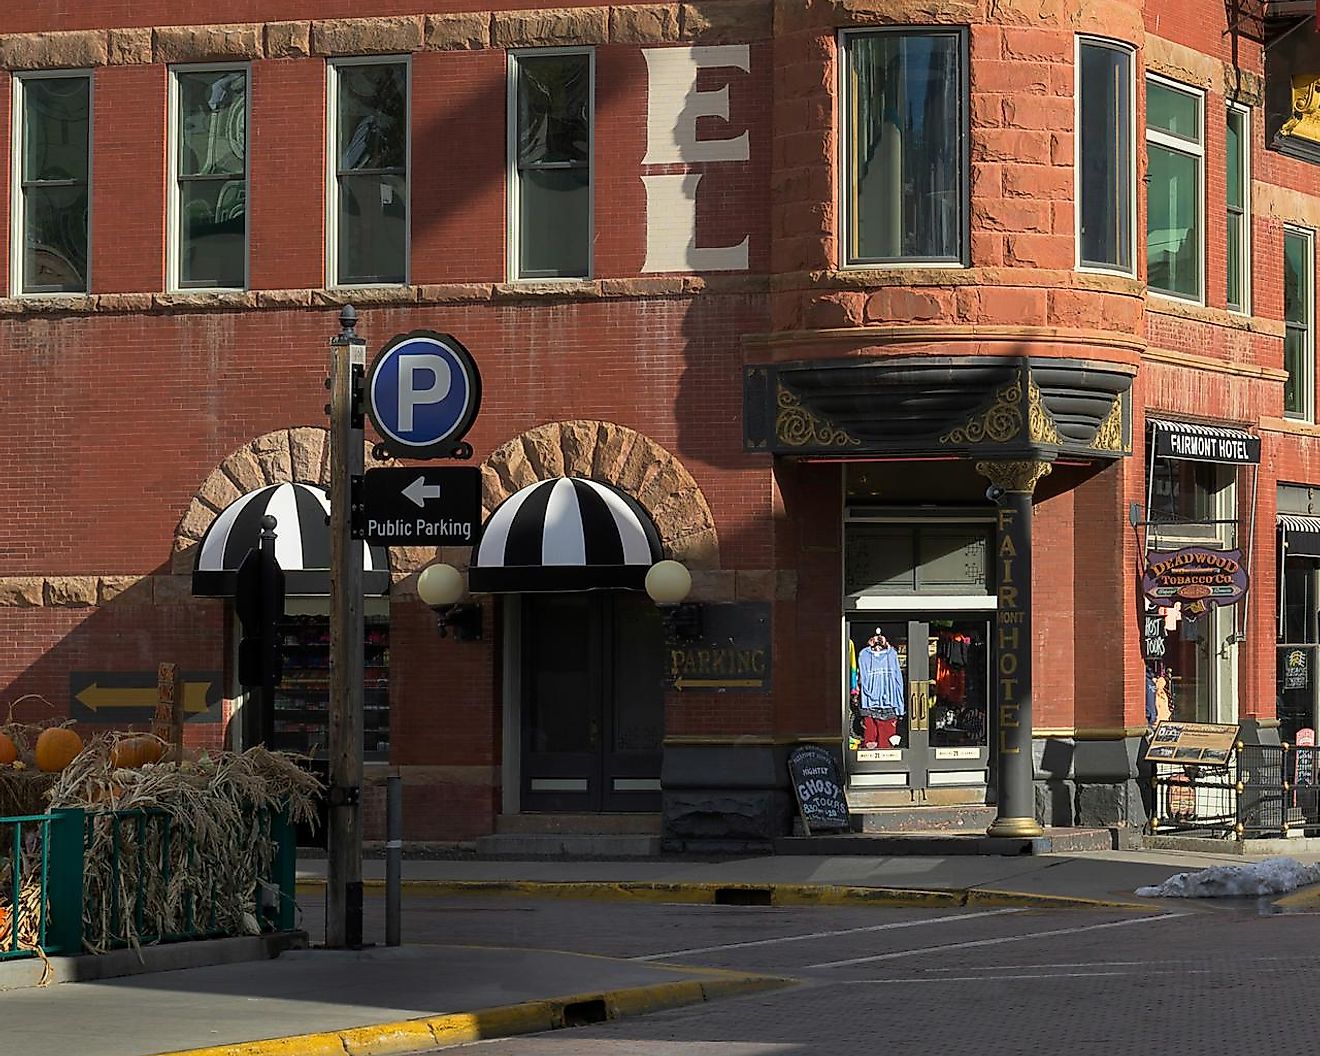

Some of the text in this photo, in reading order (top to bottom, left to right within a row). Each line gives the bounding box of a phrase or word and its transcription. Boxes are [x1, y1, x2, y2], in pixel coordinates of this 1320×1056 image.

[397, 354, 451, 432] P
[1170, 434, 1249, 459] FAIRMONT HOTEL
[368, 519, 471, 540] Public Parking
[1152, 552, 1239, 577] DEADWOOD
[1161, 575, 1214, 585] TOBACCO
[671, 649, 765, 674] PARKING
[999, 627, 1021, 754] HOTEL
[798, 779, 840, 801] GHOST
[812, 797, 846, 814] TOURS
